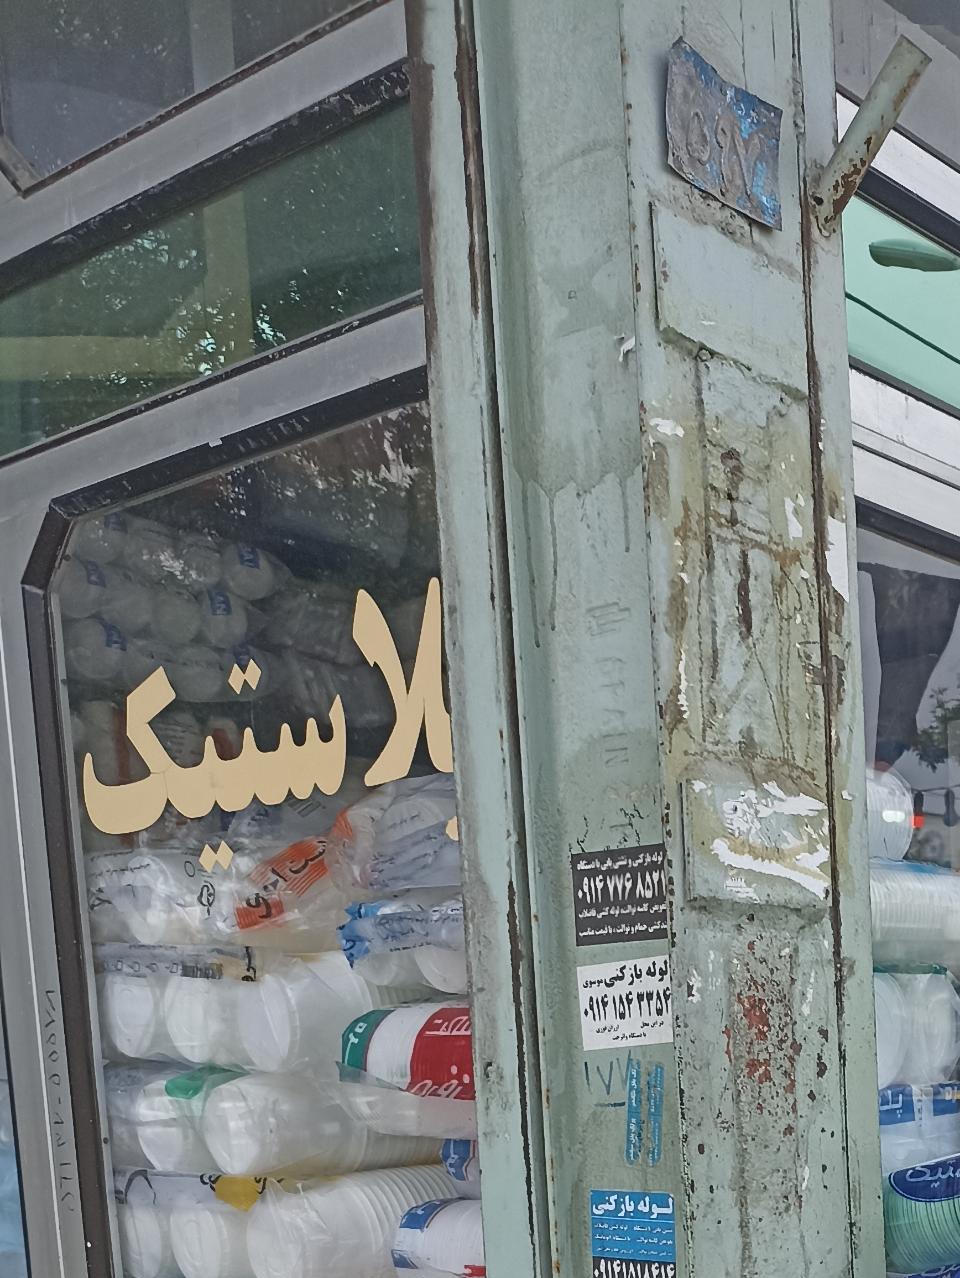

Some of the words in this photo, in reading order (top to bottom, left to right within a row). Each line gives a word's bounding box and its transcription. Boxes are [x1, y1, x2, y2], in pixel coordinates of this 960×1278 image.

[83, 576, 458, 873] لاستیک
[646, 960, 668, 982] لوله
[584, 994, 609, 1022] ۰۹۱۴
[612, 991, 634, 1020] ۱۵۴
[637, 1196, 674, 1219] لوله
